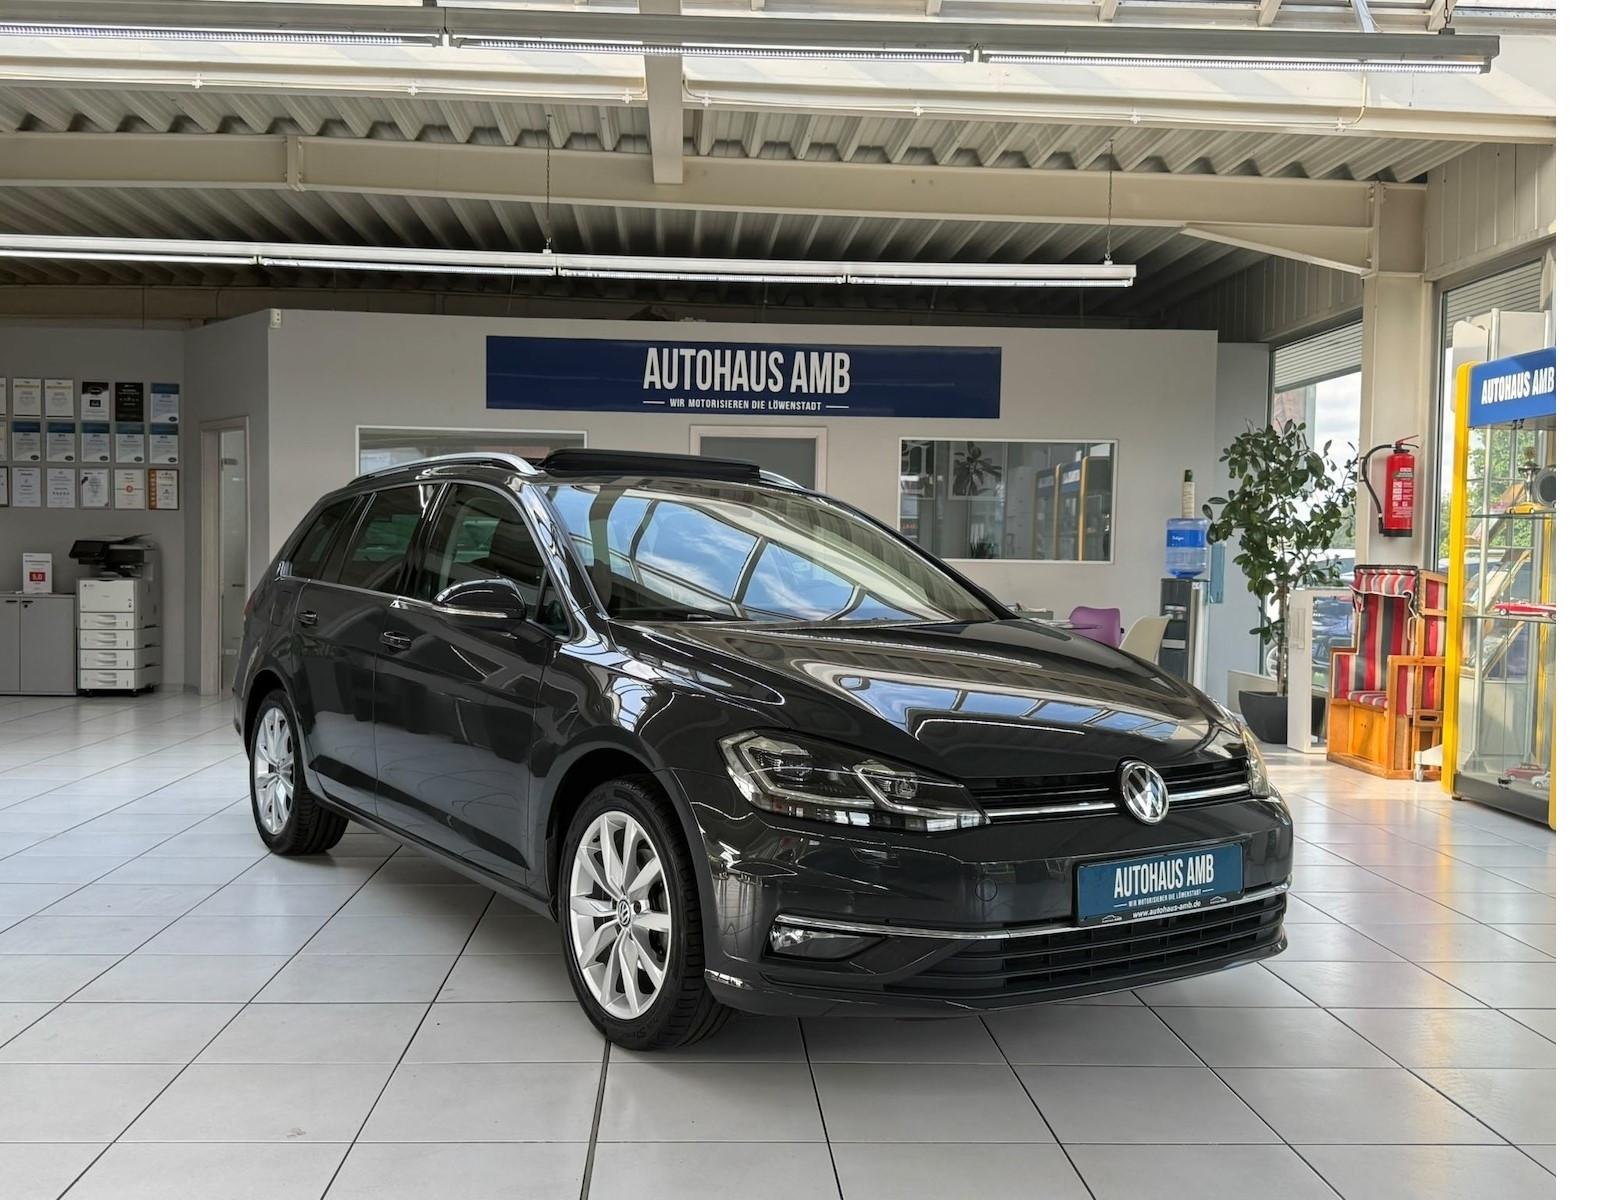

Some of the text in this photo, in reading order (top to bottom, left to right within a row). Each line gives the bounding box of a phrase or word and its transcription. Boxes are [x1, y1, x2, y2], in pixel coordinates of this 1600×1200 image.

[643, 347, 851, 394] AUTOHAUS AMB
[1481, 366, 1555, 405] AUTOHAUS AMB
[669, 398, 822, 411] WIR MOTORISIEREN DIE LÖWENSTADT
[1122, 760, 1169, 822] VW
[1114, 854, 1214, 898] AUTOHAUS AMB
[1132, 900, 1201, 918] www.autohaus-amb.de
[1168, 893, 1176, 901] DIE
